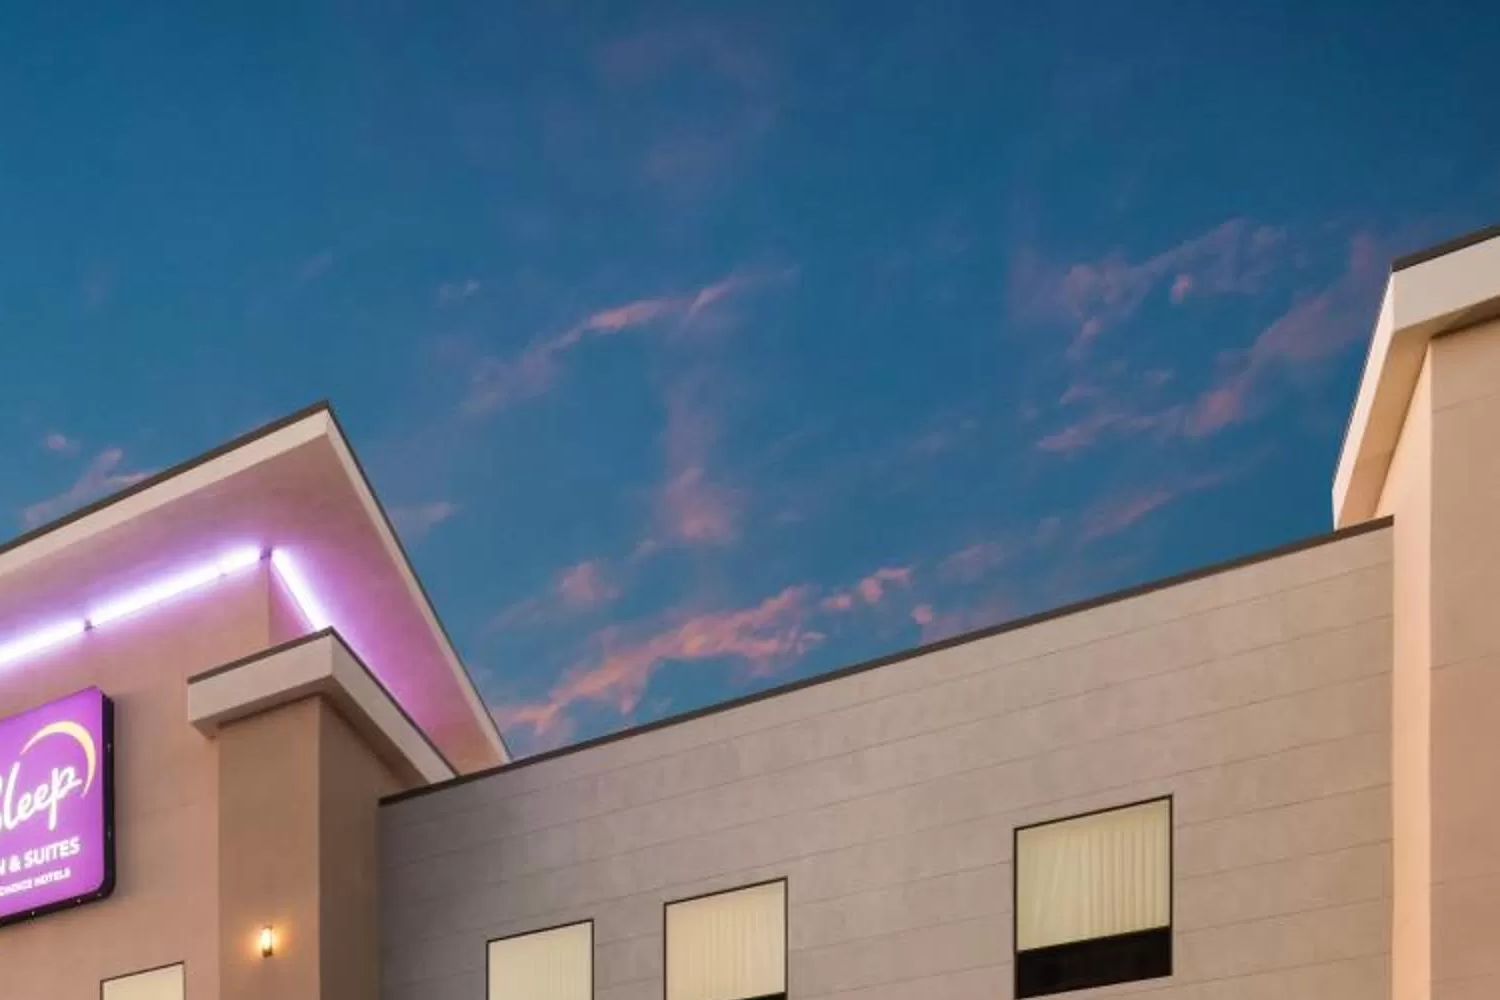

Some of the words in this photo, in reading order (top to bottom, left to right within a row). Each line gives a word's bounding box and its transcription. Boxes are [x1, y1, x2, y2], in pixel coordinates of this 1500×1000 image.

[9, 854, 21, 873] &
[24, 836, 81, 869] SUITES
[34, 867, 71, 887] HOTELS
